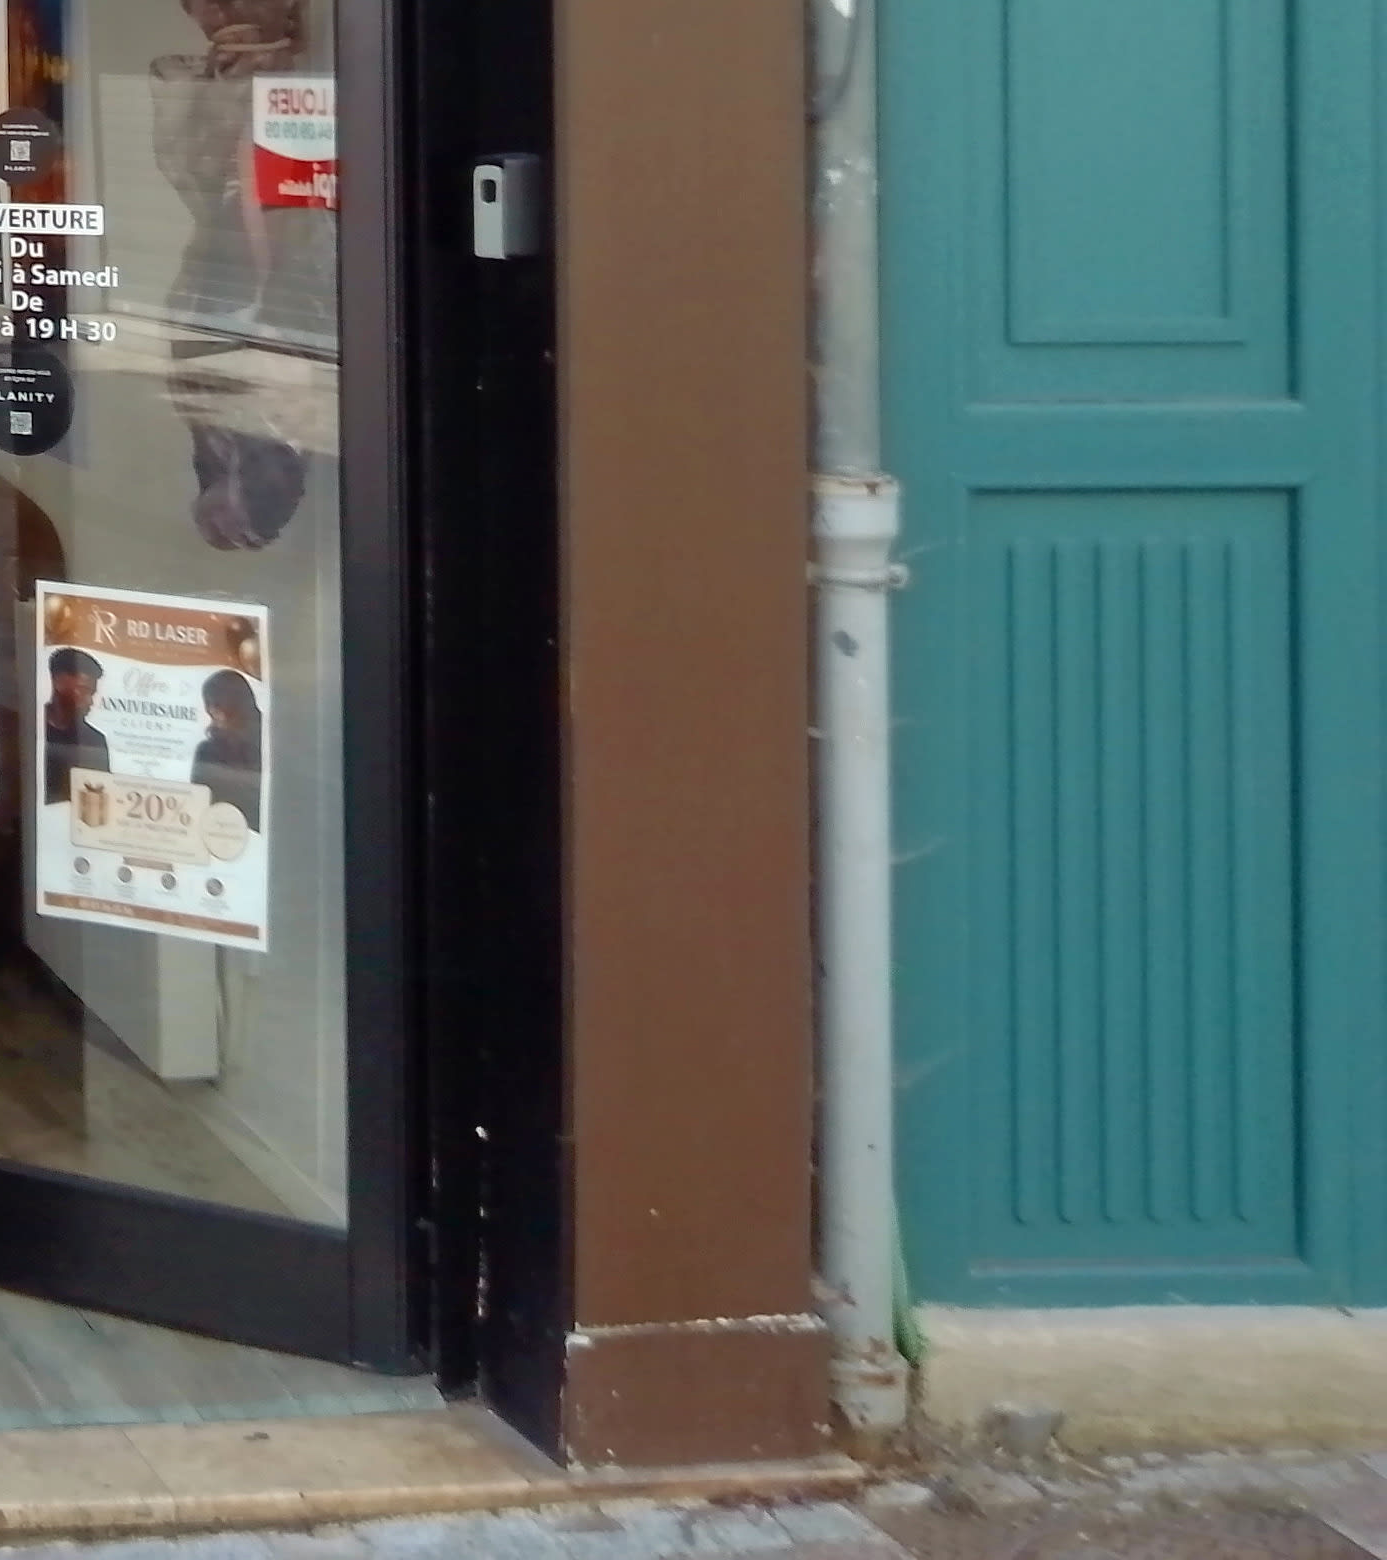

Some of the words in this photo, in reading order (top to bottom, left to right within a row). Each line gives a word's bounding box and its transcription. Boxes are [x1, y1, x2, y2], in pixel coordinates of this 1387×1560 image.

[10, 237, 44, 259] Du
[12, 264, 27, 284] à
[30, 263, 120, 288] Samedi
[11, 290, 43, 312] De
[1, 316, 14, 338] à
[26, 317, 54, 339] 19
[60, 319, 78, 340] H
[87, 320, 117, 342] 30
[126, 619, 149, 638] RD
[154, 622, 209, 646] LASER
[99, 696, 197, 721] ANNIVERSAIRE
[116, 791, 192, 826] -20%
